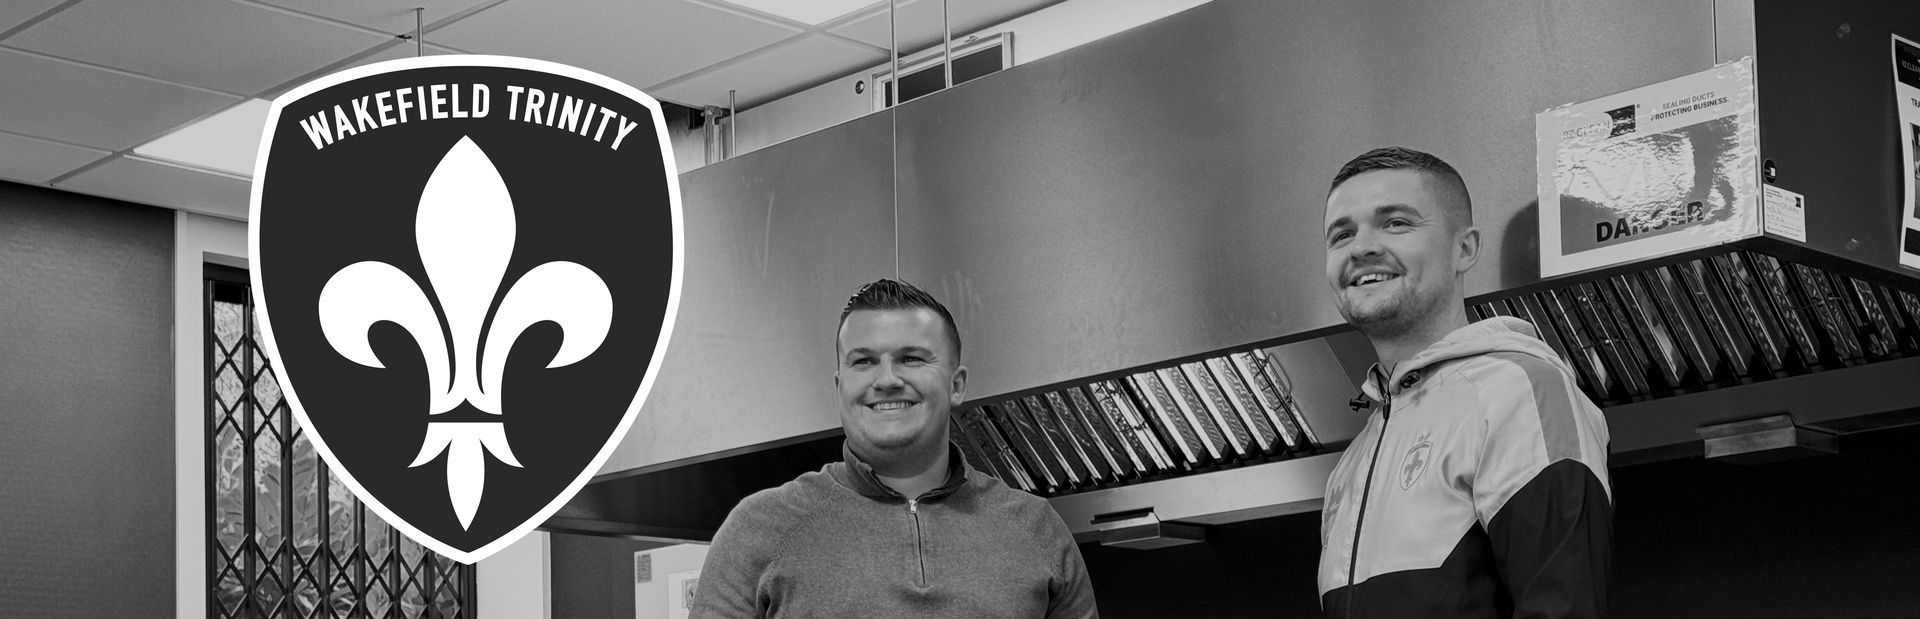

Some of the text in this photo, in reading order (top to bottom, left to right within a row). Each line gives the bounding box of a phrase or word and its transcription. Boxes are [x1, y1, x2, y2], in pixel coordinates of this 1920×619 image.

[1662, 91, 1715, 110] SEALING DUCTS
[1650, 106, 1693, 121] PROTECTING
